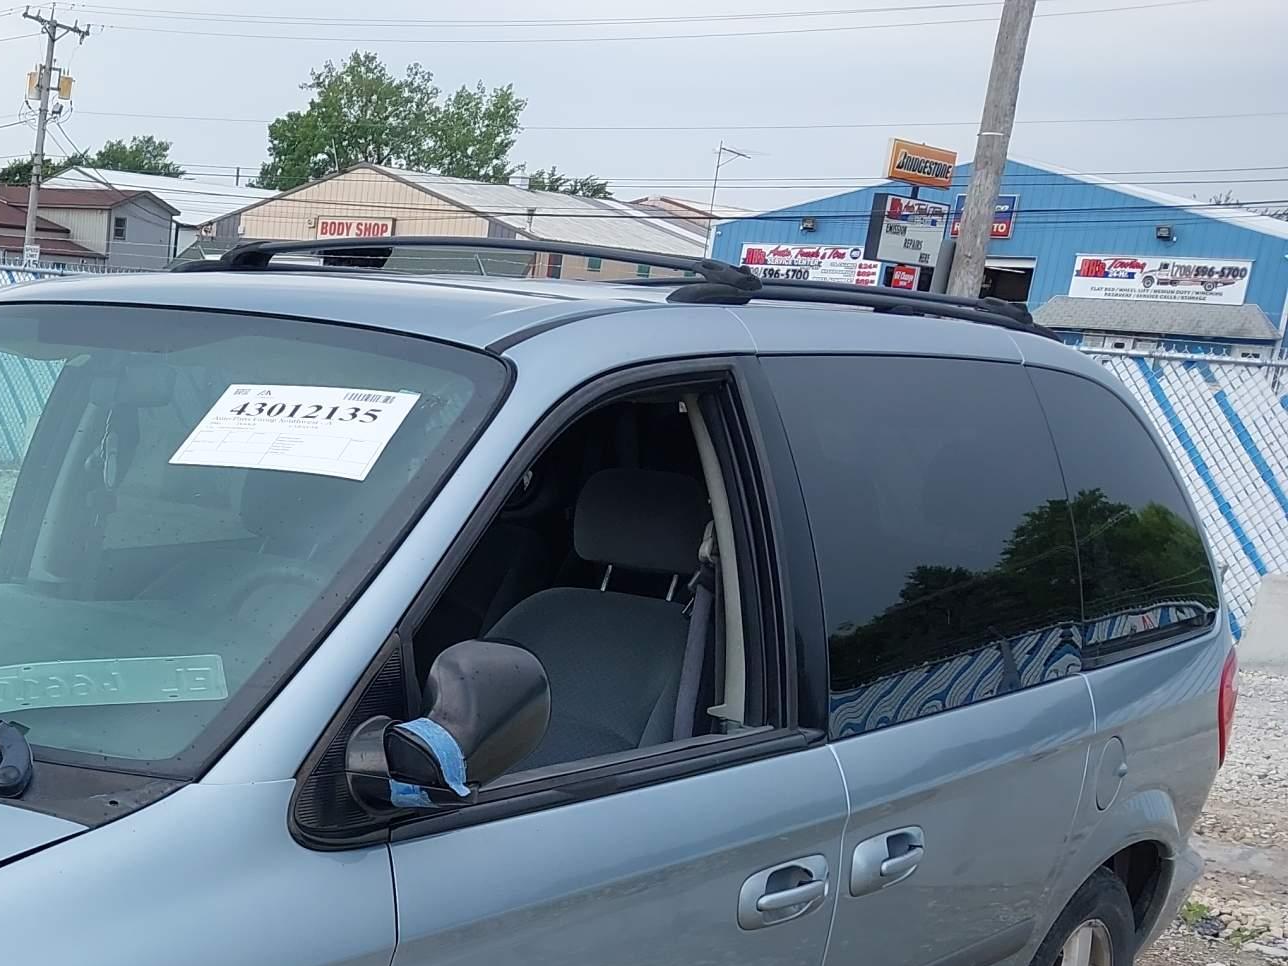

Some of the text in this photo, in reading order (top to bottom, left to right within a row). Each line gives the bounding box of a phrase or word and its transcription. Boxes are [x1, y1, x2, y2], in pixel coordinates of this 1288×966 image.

[896, 152, 952, 180] BRIDGESTONE
[320, 221, 389, 237] BODY SHOP
[886, 223, 907, 236] EMISSION
[904, 239, 923, 250] REPAIRS
[767, 257, 819, 267] SERVICE CENTER
[1103, 257, 1147, 274] Towing
[229, 401, 383, 424] 43012135
